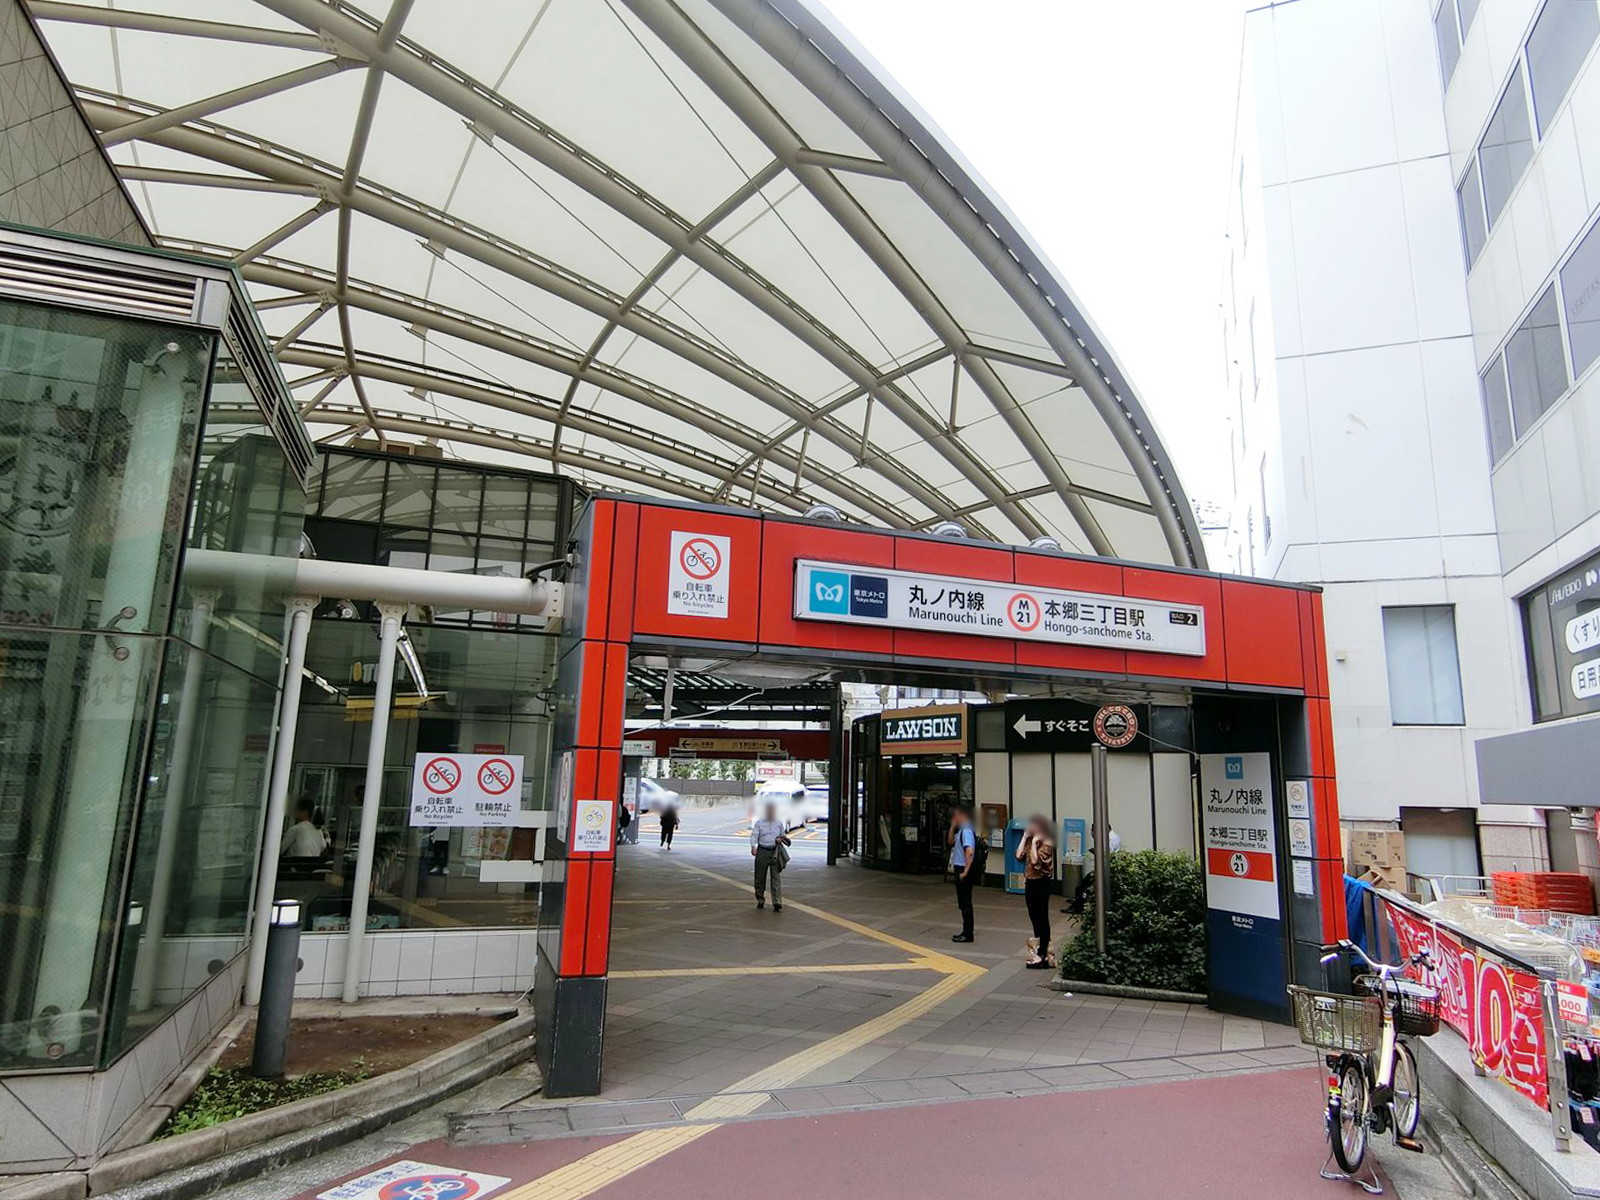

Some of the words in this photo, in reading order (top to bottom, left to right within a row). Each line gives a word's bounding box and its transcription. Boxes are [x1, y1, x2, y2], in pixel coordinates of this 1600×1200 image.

[686, 582, 713, 592] 自転車
[673, 590, 725, 604] 乗り入れ禁止
[853, 589, 885, 599] 東京メトロ
[909, 585, 985, 611] 丸ノ内線
[1018, 600, 1029, 610] M
[909, 607, 977, 624] Marunouchi
[981, 613, 1004, 627] Line
[1016, 612, 1031, 624] 21
[1044, 600, 1146, 627] 本郷三丁目駅
[1187, 613, 1194, 625] 2
[1044, 620, 1133, 640] Hongo-sanchome
[1135, 629, 1155, 641] Sta.
[1573, 615, 1600, 644] くすり
[1578, 664, 1600, 690] 日用
[886, 717, 957, 740] LAWSON
[1044, 720, 1090, 732] すぐそこ
[427, 797, 453, 805] 自転車
[1210, 788, 1263, 805] 丸ノ内線
[414, 805, 464, 814] 乗り入れ禁止
[475, 802, 512, 812] 駐輪禁止
[1208, 805, 1250, 814] Marunouchi
[1251, 807, 1267, 816] Line
[1209, 826, 1269, 841] 本郷三丁目駅
[1233, 862, 1244, 872] 21
